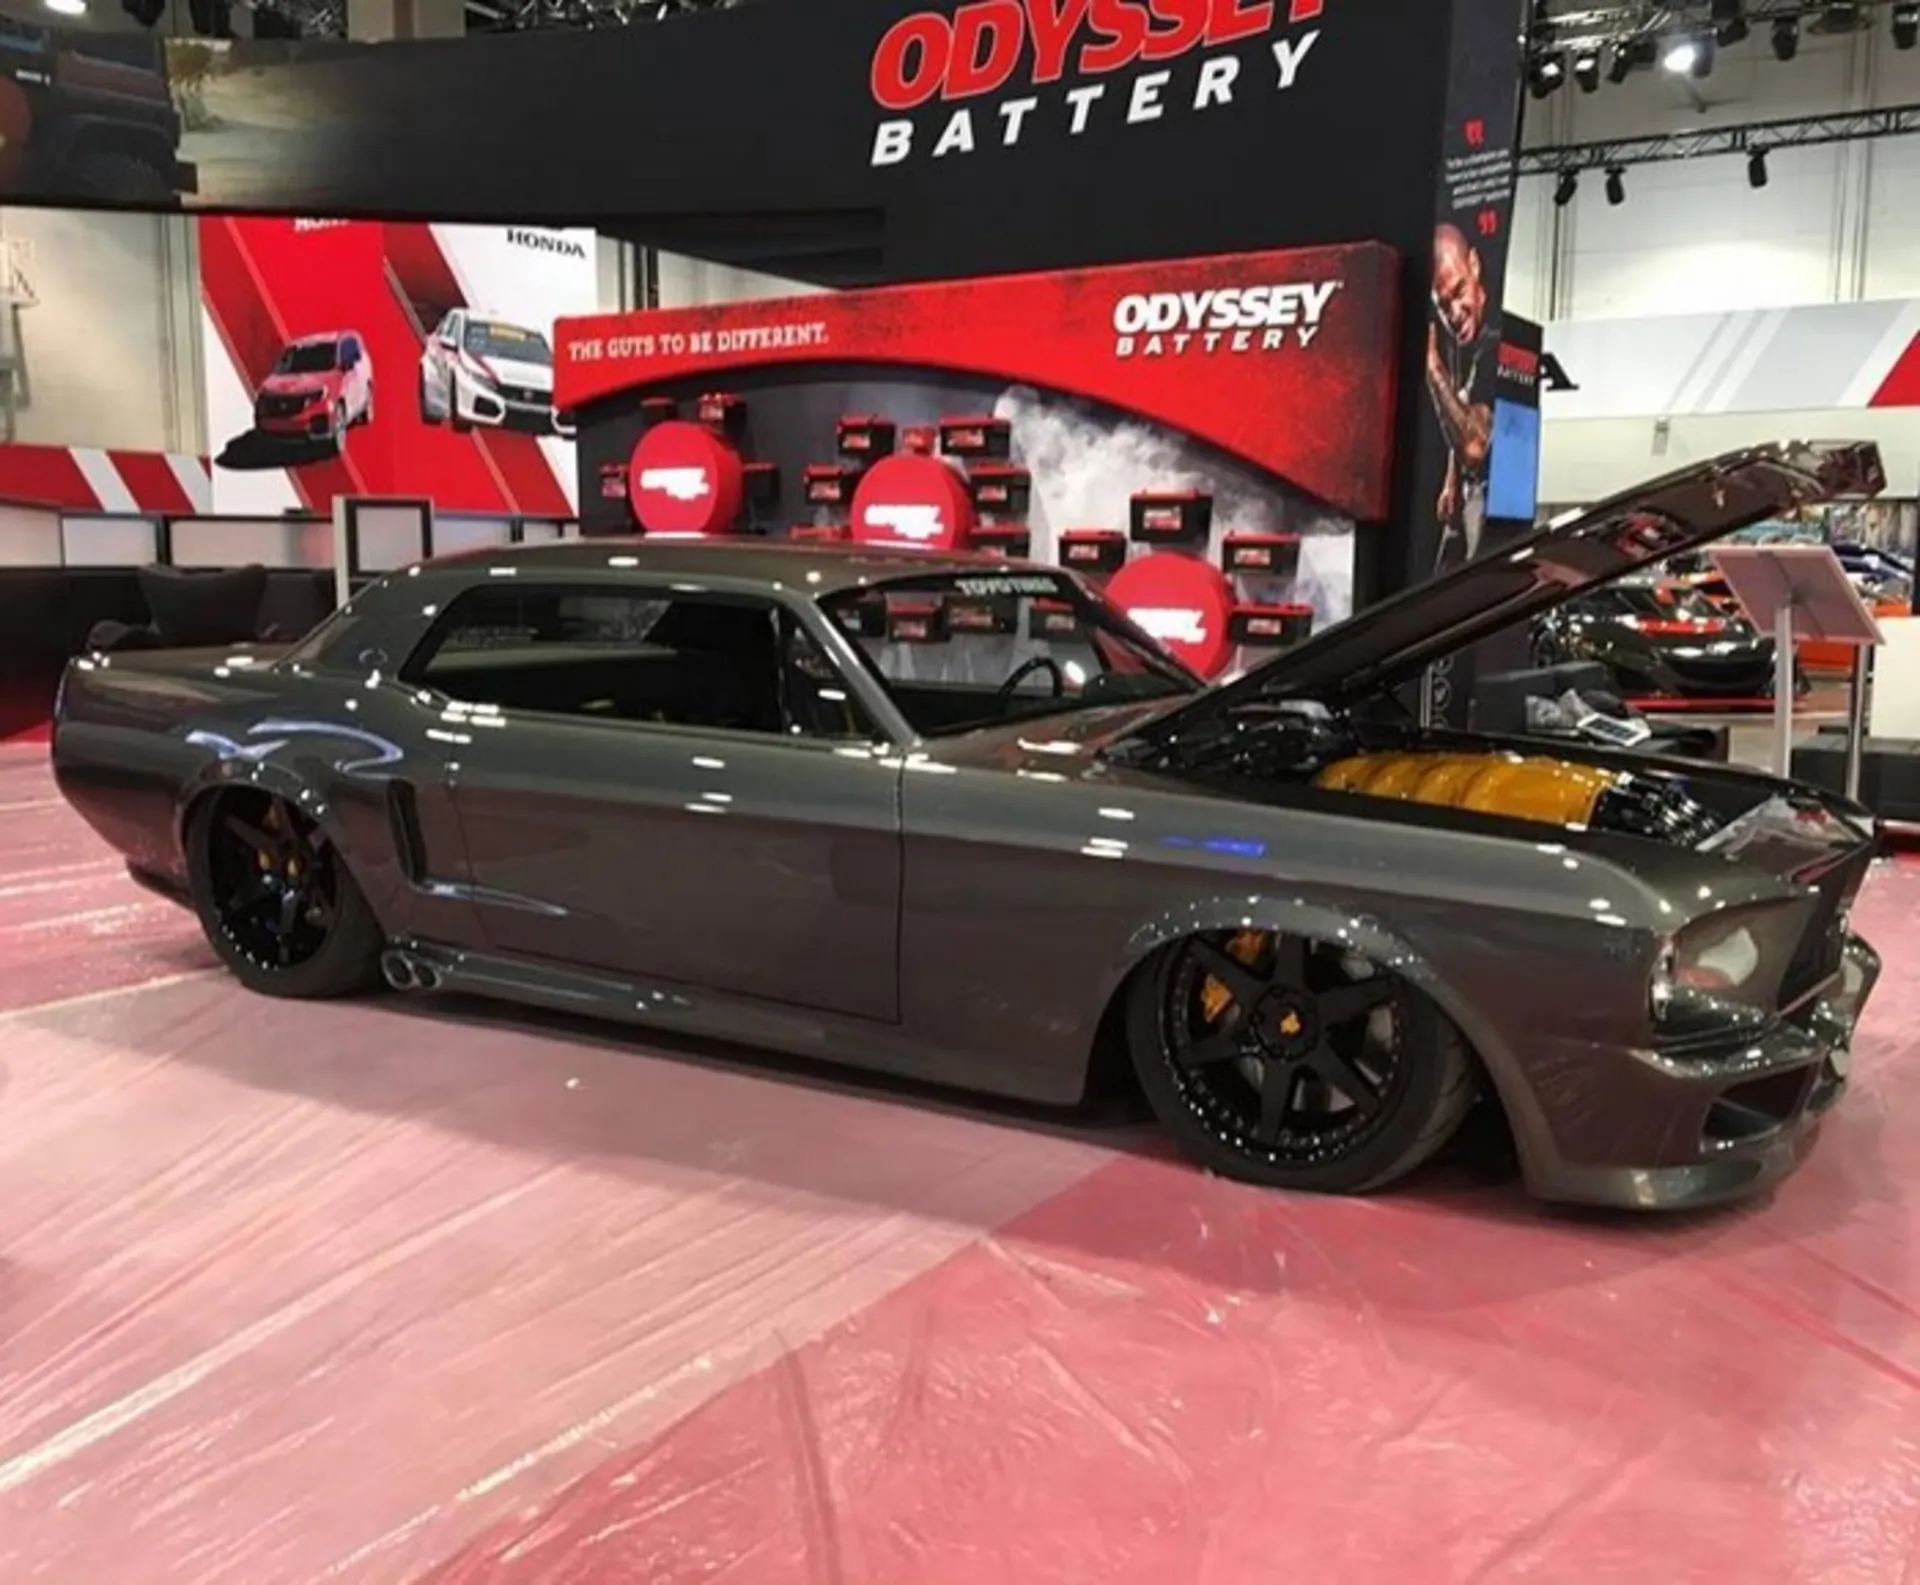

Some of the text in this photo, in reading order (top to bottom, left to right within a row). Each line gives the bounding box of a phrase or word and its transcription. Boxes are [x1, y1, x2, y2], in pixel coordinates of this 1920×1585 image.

[871, 0, 1324, 110] ODYSS
[871, 30, 1320, 166] BATTERY
[507, 228, 586, 259] HONDA
[1113, 281, 1338, 333] ODYSSEY
[568, 322, 830, 362] THE GUTS TO BE DIFFERENT.
[1116, 326, 1318, 357] BATTERY
